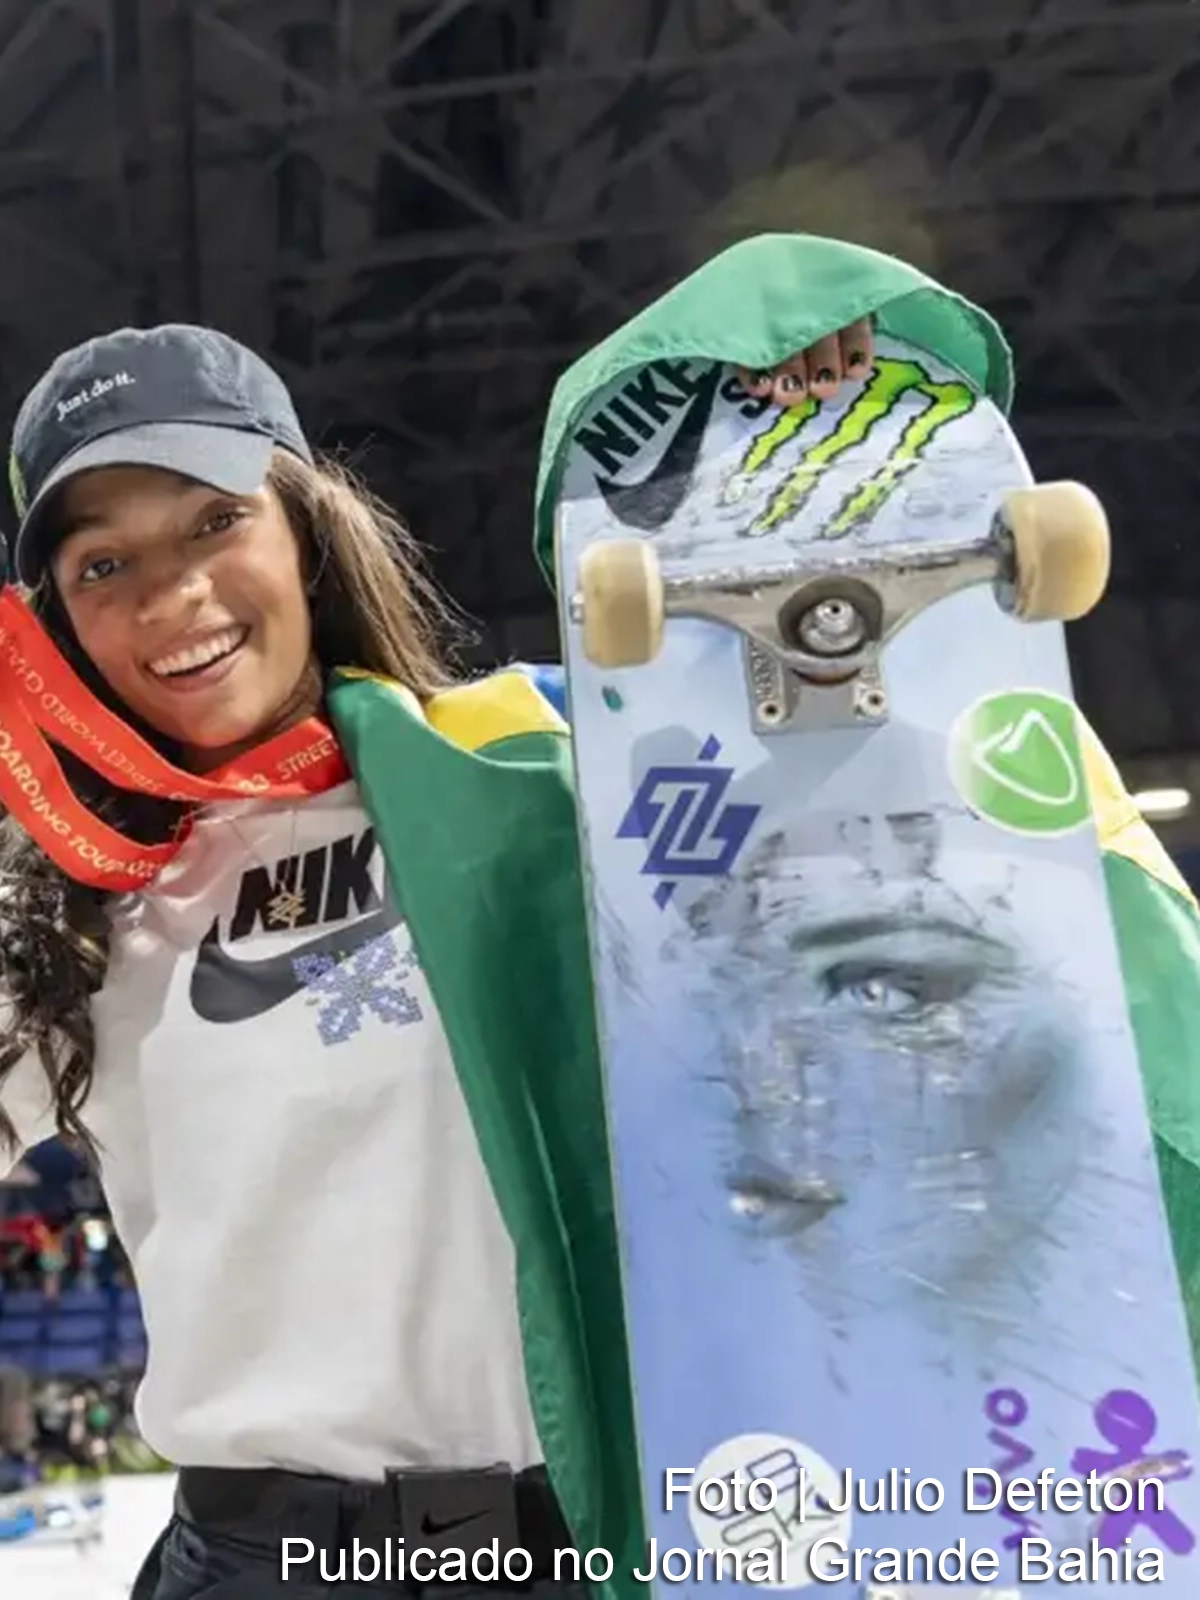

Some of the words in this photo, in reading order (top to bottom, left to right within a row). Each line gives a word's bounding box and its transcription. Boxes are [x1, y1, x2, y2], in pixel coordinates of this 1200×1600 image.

[57, 389, 91, 422] Just
[91, 378, 115, 397] do
[573, 358, 711, 477] NIKE
[40, 692, 107, 754] WORLD
[229, 824, 380, 943] NIK
[975, 1387, 1042, 1551] vvo
